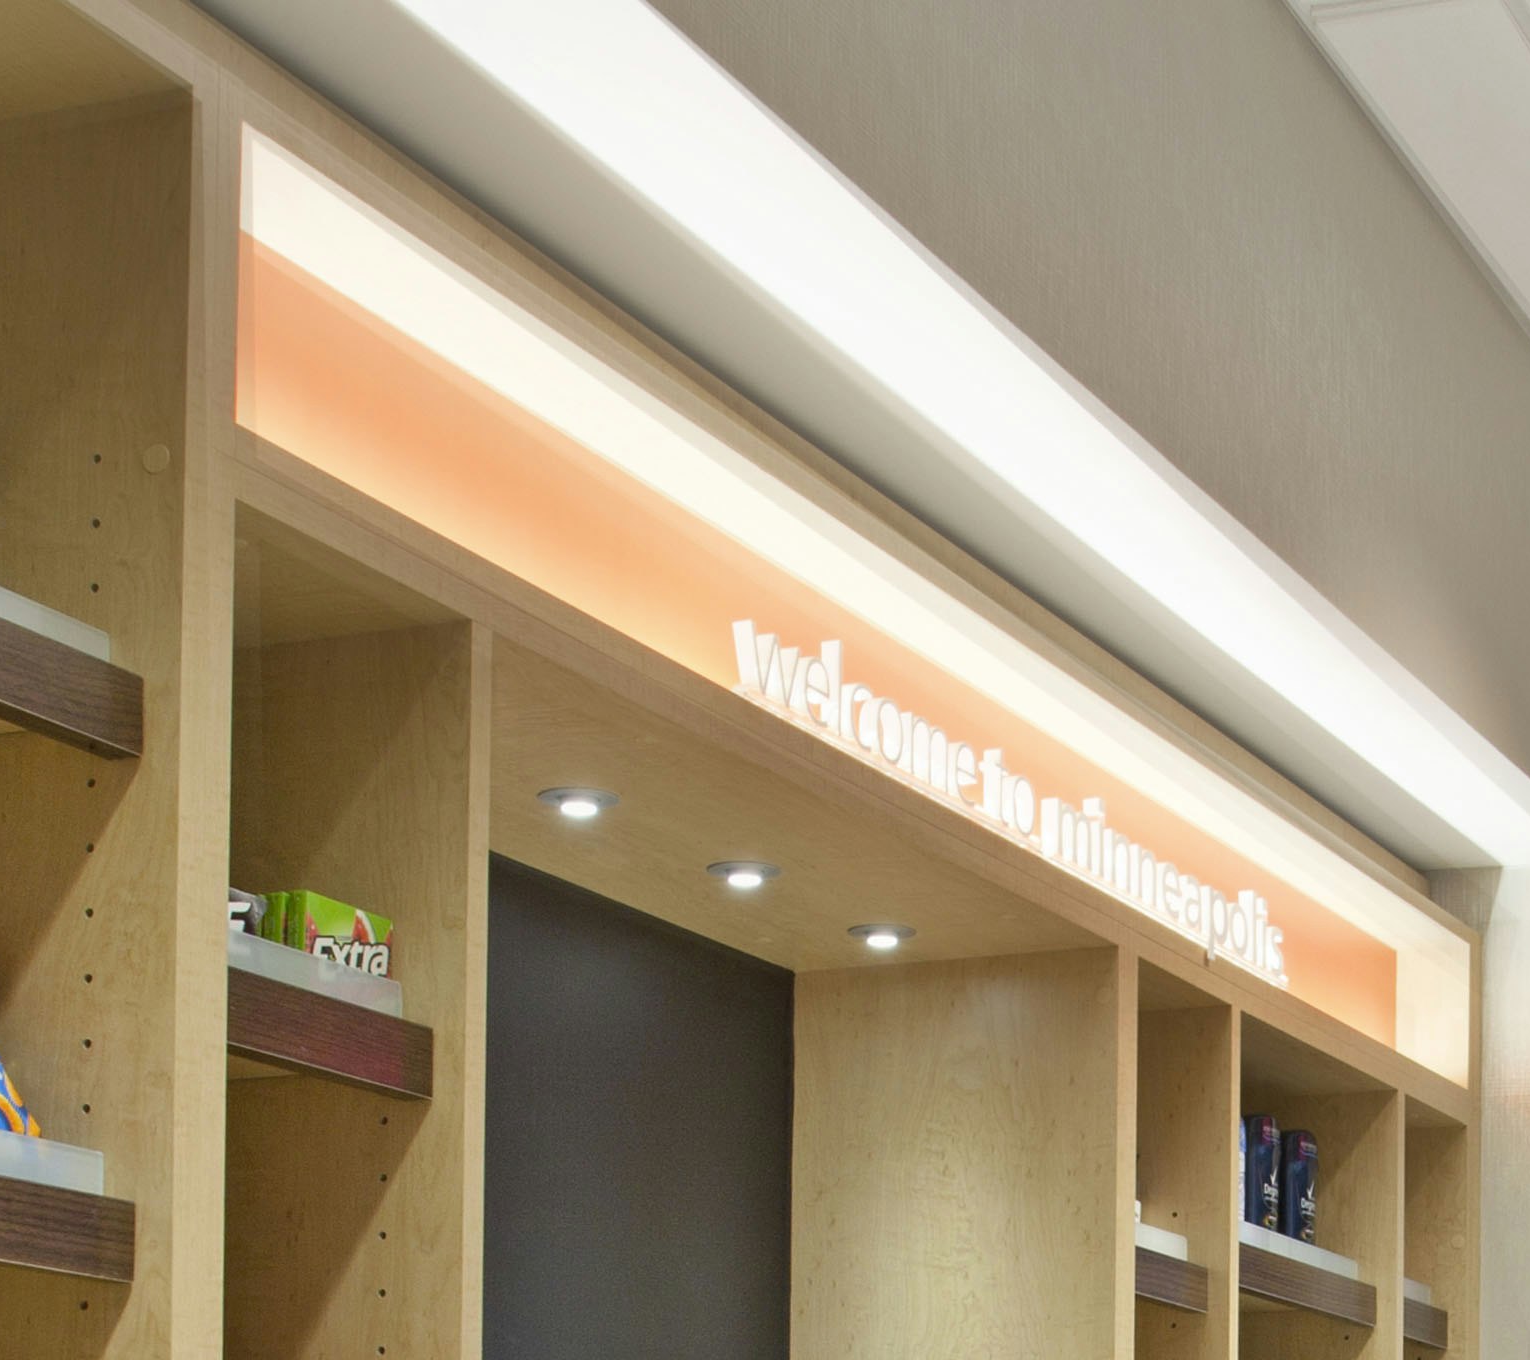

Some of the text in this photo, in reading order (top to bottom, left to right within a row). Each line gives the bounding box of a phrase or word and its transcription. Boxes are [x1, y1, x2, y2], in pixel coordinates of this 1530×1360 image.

[732, 619, 1289, 987] welcome to minneapolis
